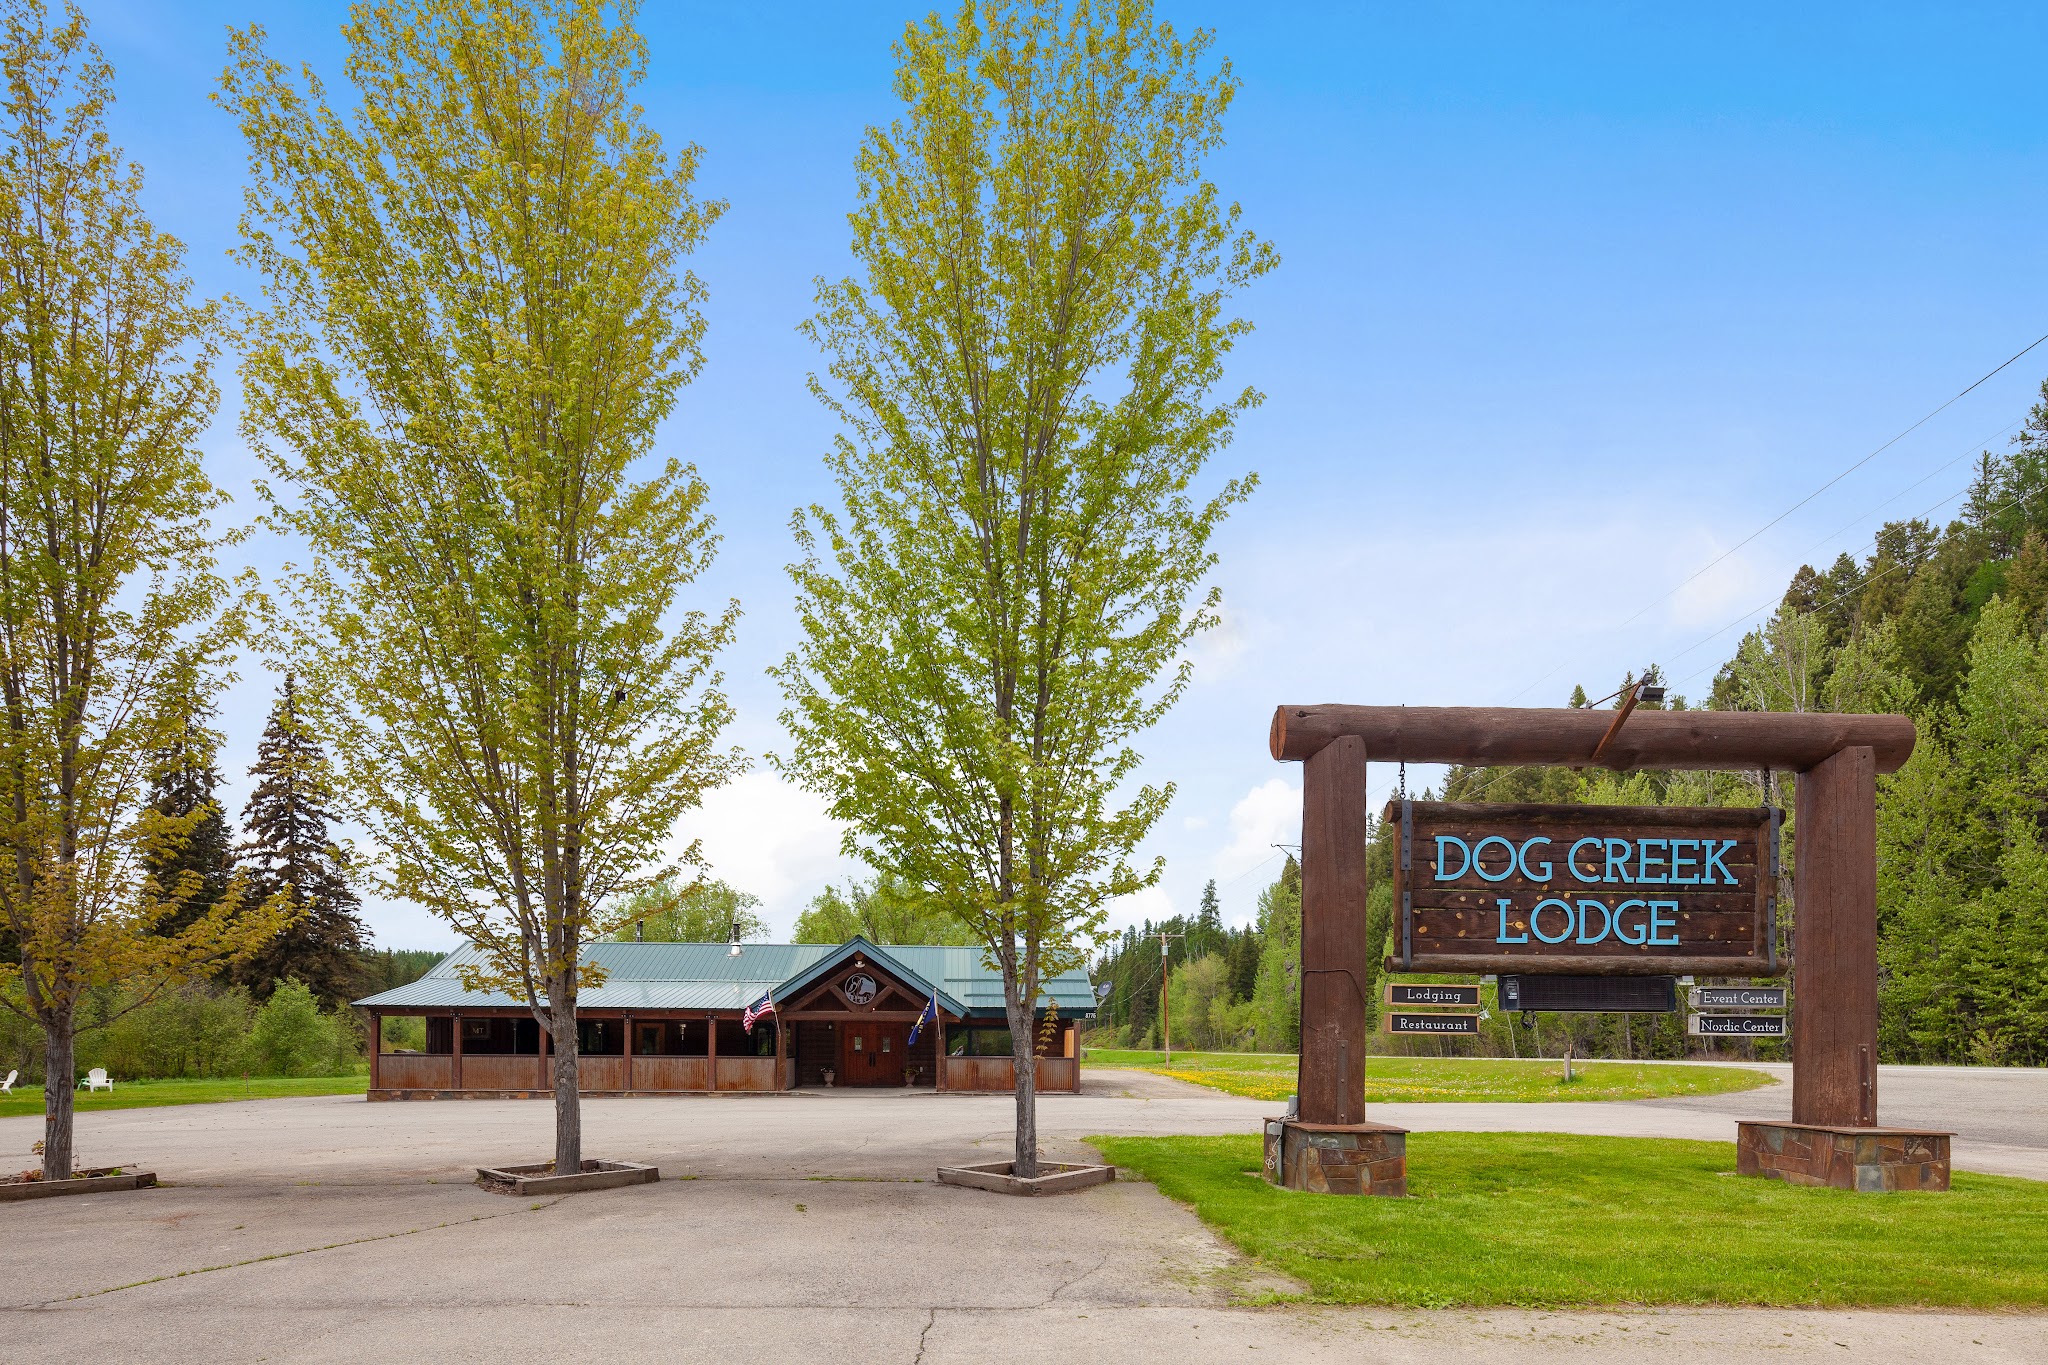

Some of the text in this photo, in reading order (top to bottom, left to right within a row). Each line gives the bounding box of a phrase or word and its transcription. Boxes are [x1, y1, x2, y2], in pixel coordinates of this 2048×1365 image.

[1434, 835, 1739, 885] DOG CREEK
[1496, 898, 1679, 946] LODGE
[1407, 988, 1461, 1003] Lodging
[1703, 992, 1779, 1004] Event Center
[1400, 1018, 1468, 1030] Restaurant
[1700, 1019, 1780, 1033] Nordic Center
